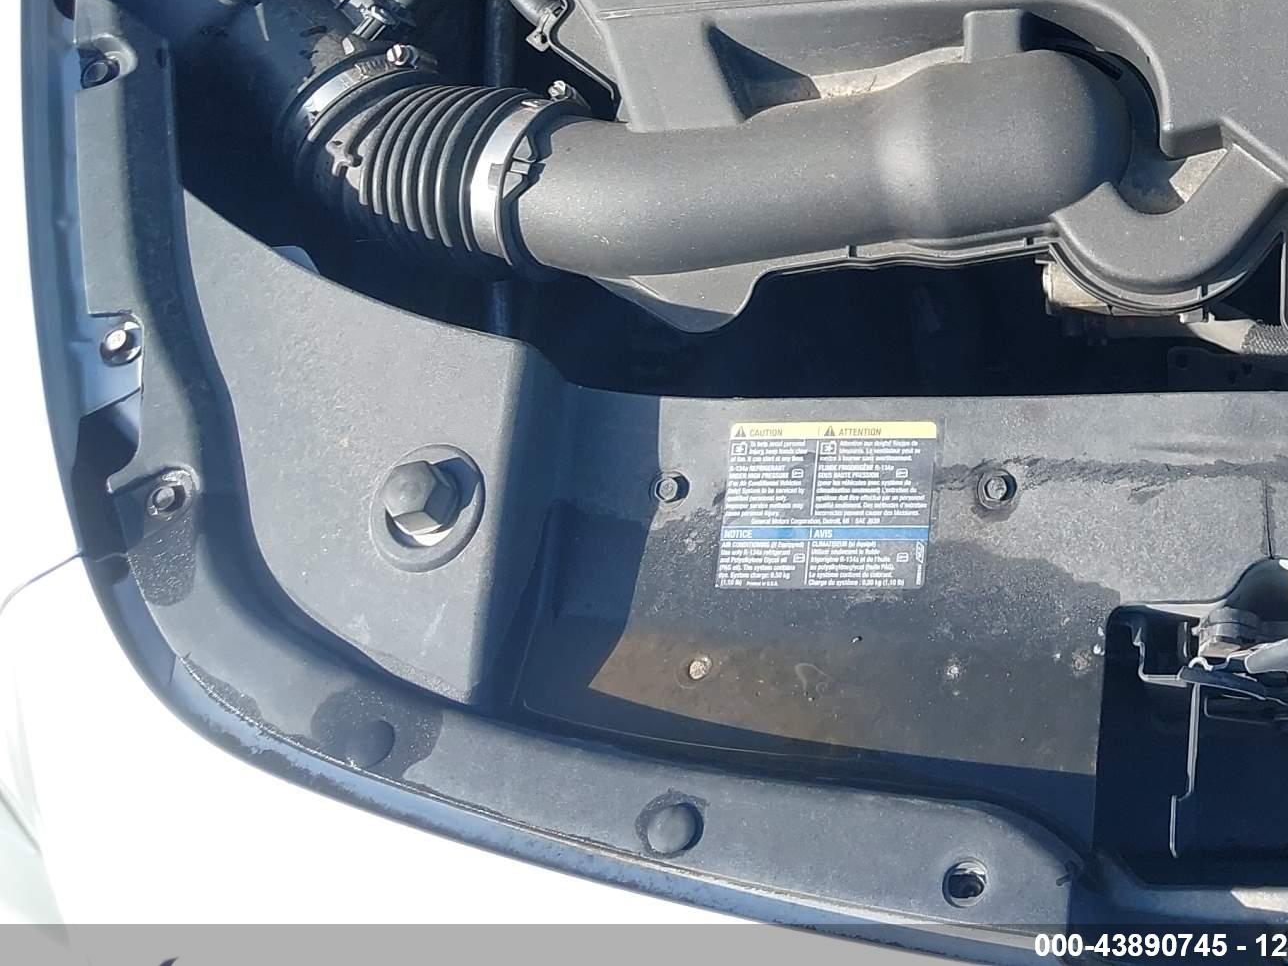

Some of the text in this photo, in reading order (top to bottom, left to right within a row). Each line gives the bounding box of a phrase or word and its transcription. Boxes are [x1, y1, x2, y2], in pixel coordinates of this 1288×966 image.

[749, 428, 783, 437] CAUTION
[838, 428, 882, 436] ATTENTION
[723, 529, 753, 539] NOTICE
[813, 529, 833, 539] AVIS
